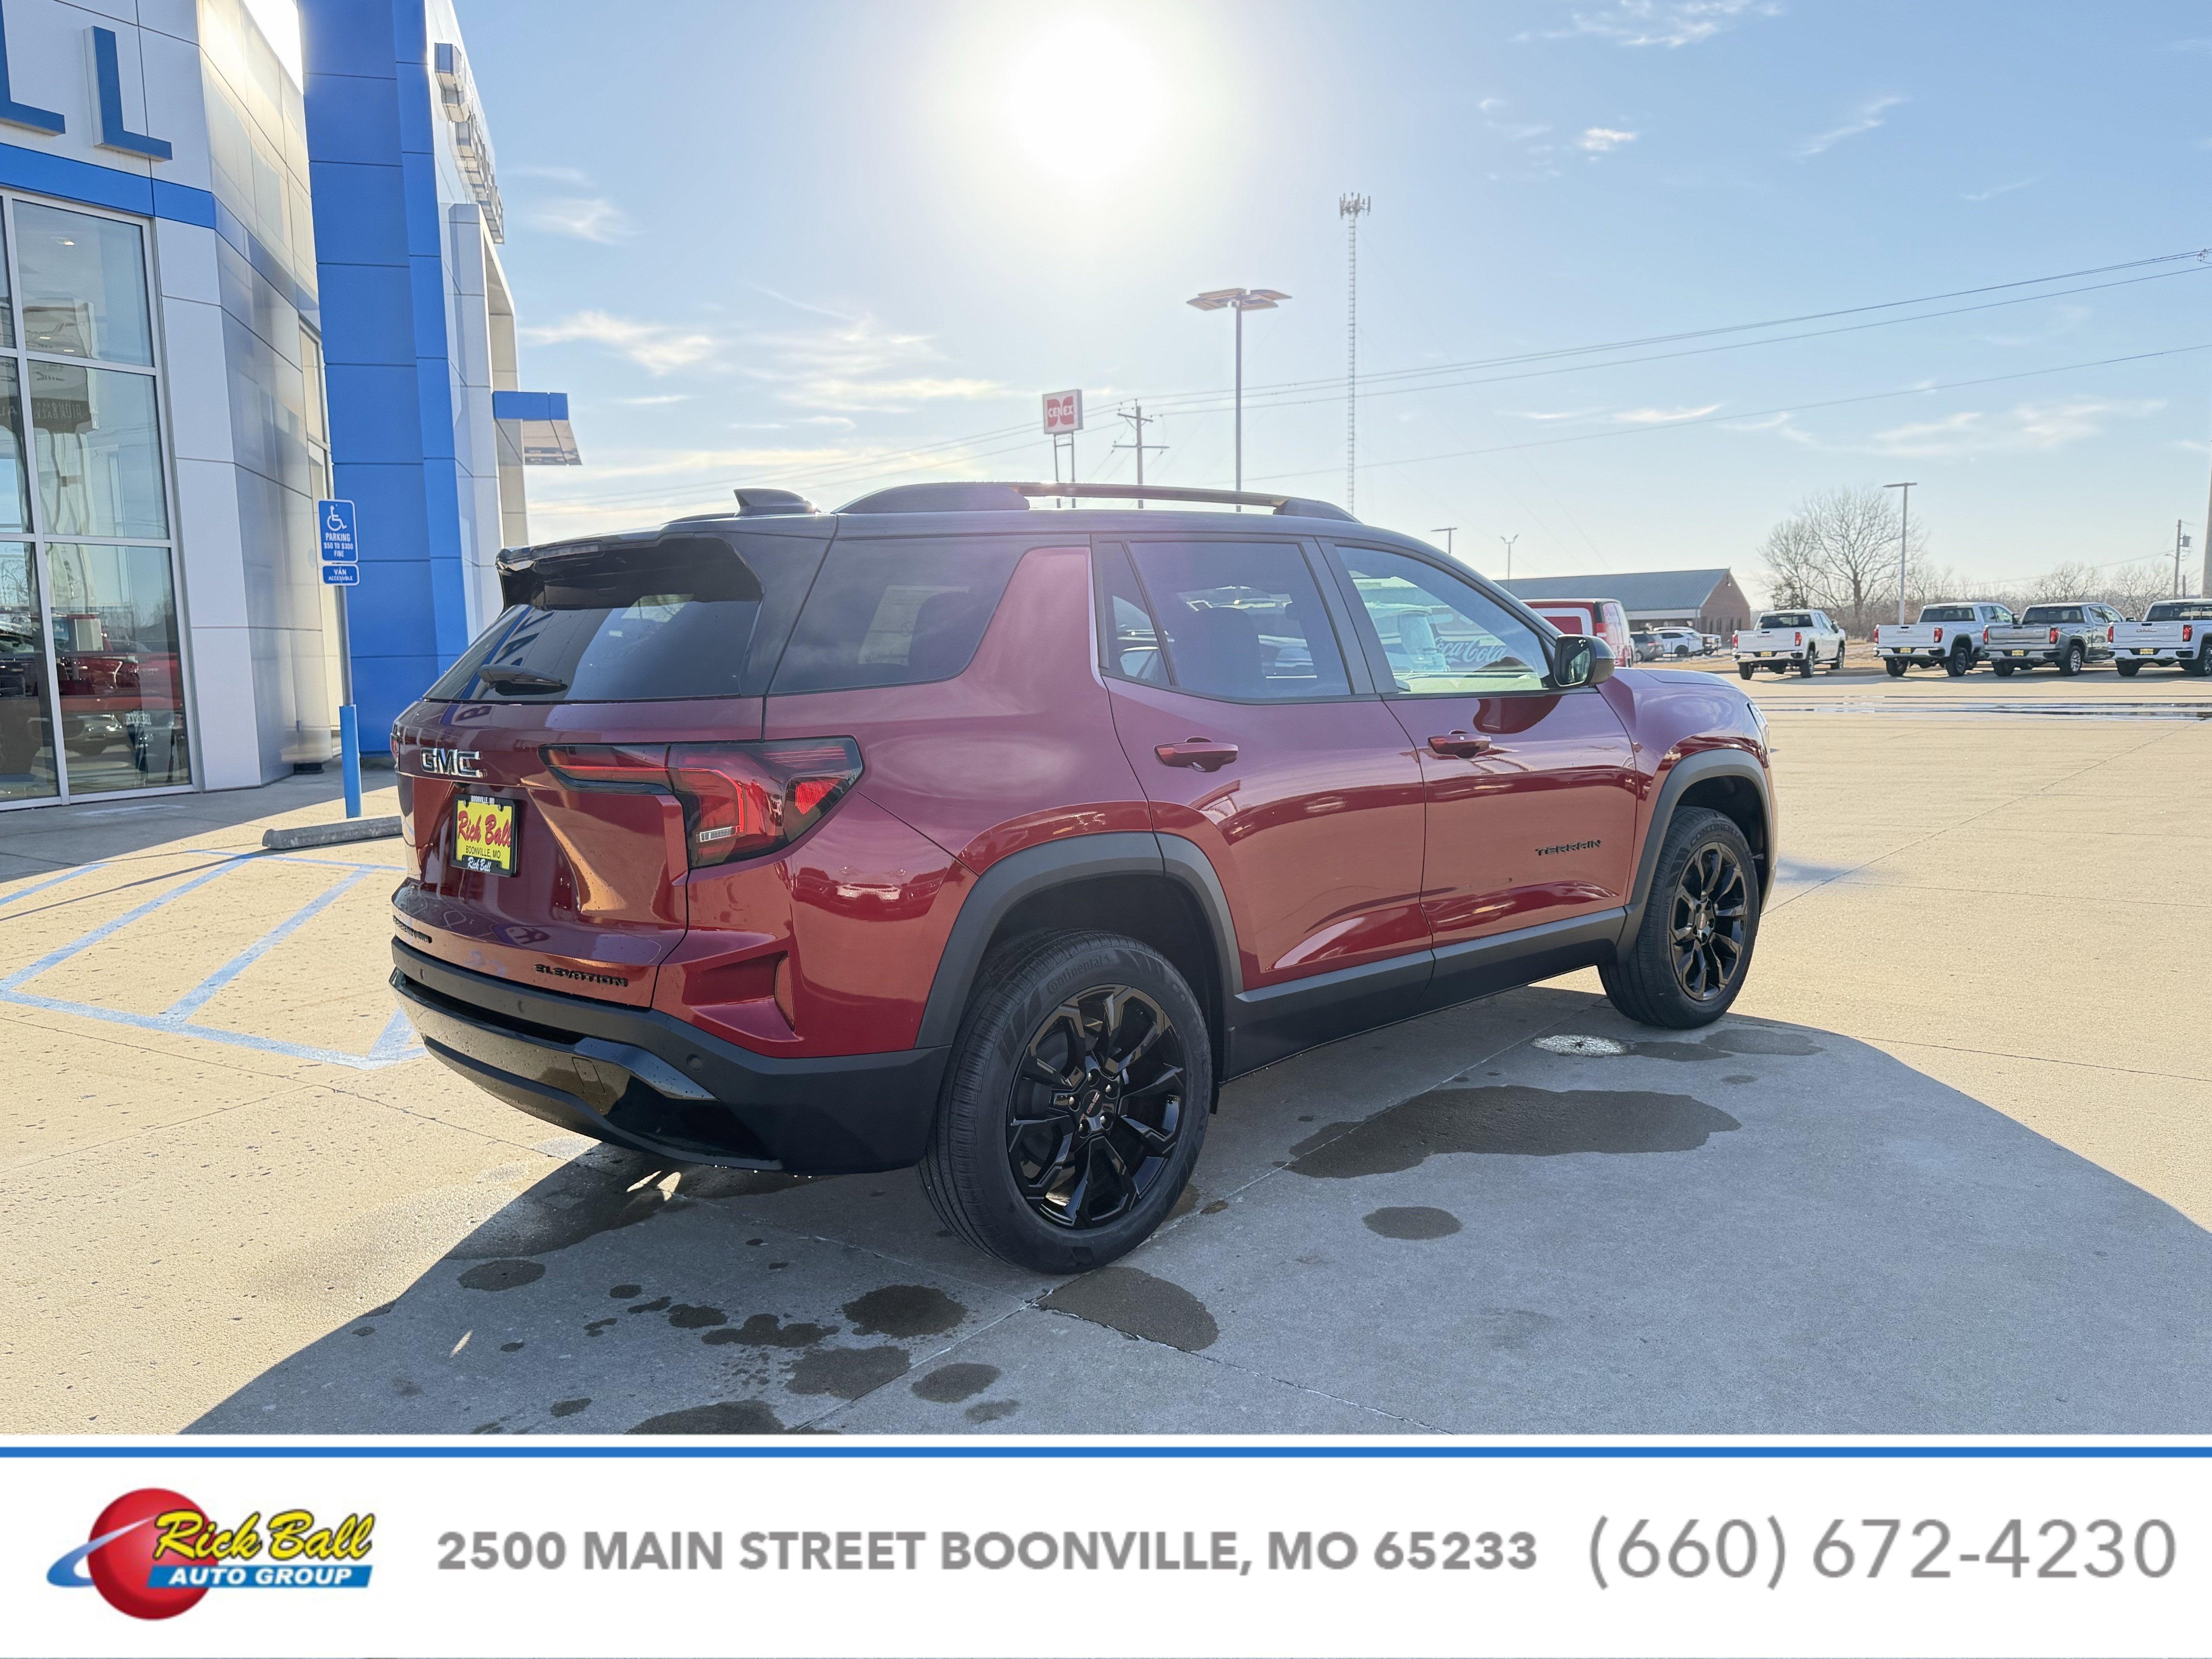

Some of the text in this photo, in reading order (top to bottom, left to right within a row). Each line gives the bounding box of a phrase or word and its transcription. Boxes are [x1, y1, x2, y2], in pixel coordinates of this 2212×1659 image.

[325, 532, 350, 541] PARKING
[421, 747, 487, 778] GMC
[458, 810, 511, 848] Rick Ball
[466, 845, 501, 859] BOONVILLE, MO
[1535, 840, 1602, 856] TERRAIN
[467, 856, 492, 872] Rick Ball
[534, 964, 629, 987] ELEVATION
[1046, 955, 1104, 995] Continental
